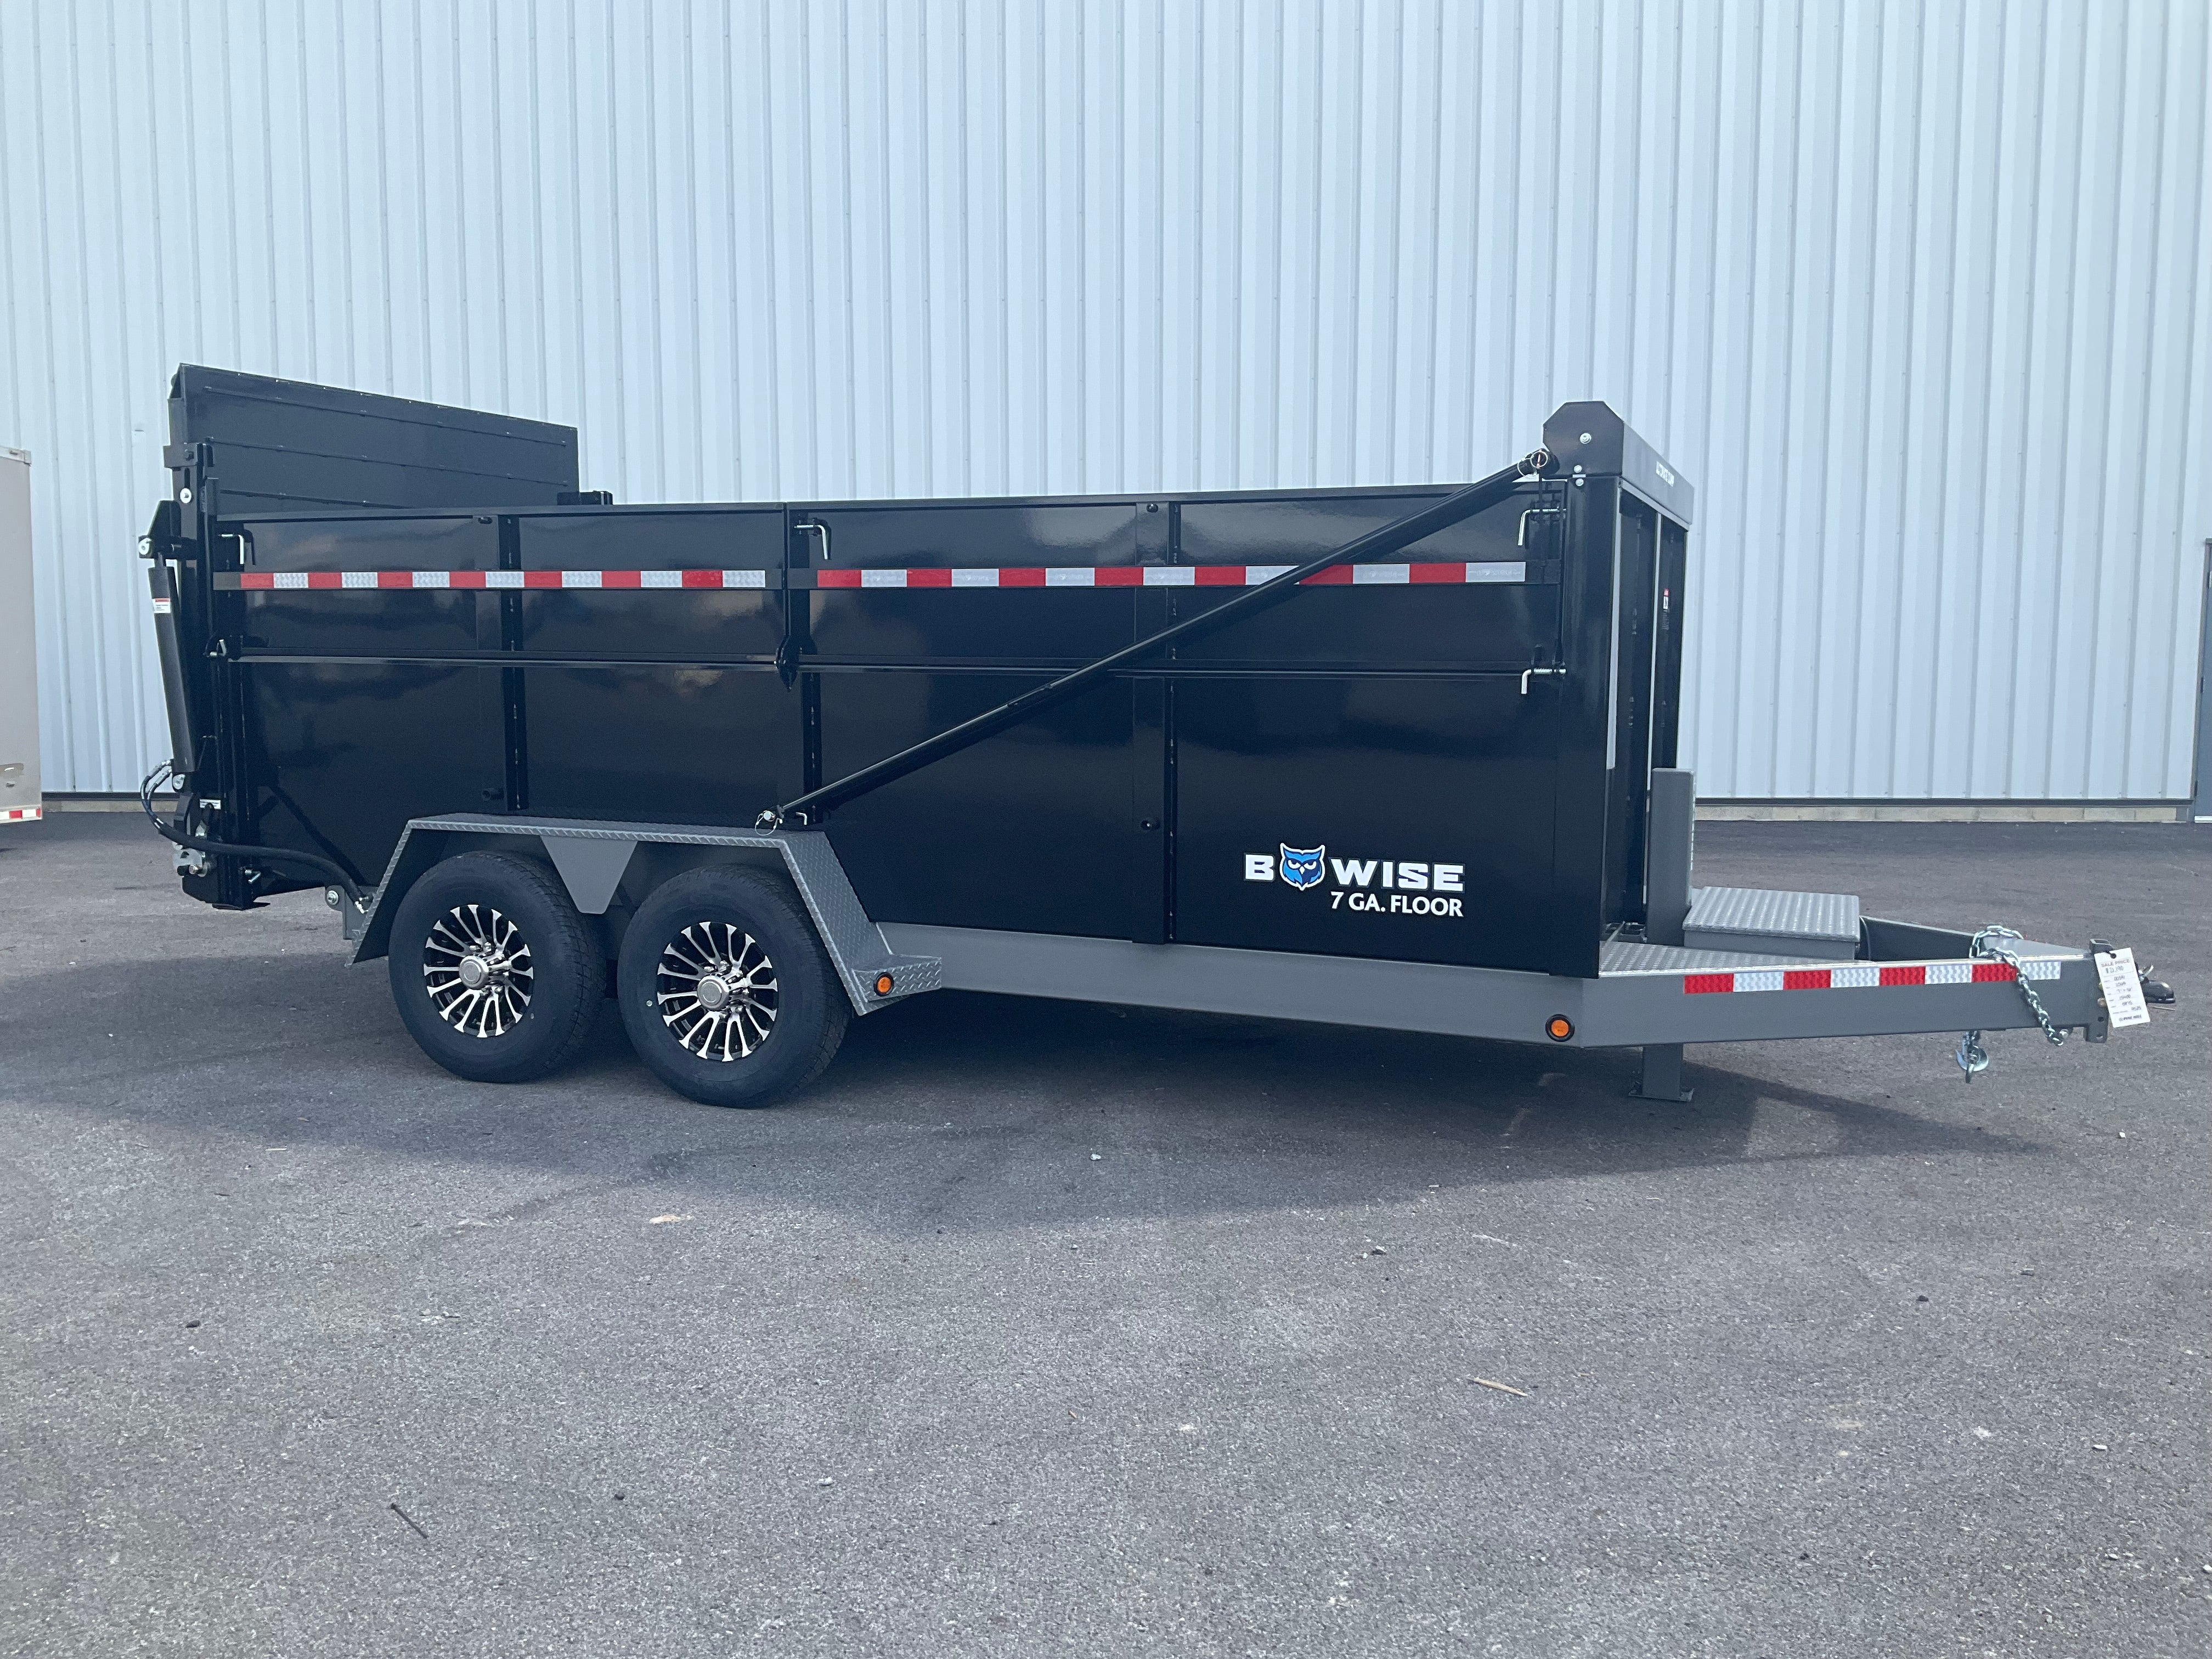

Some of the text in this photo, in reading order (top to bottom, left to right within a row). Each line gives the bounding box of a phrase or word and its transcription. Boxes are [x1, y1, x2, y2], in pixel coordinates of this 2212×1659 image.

[1330, 859, 1464, 892] WISE
[1330, 891, 1464, 917] 7 GA. FLOOR
